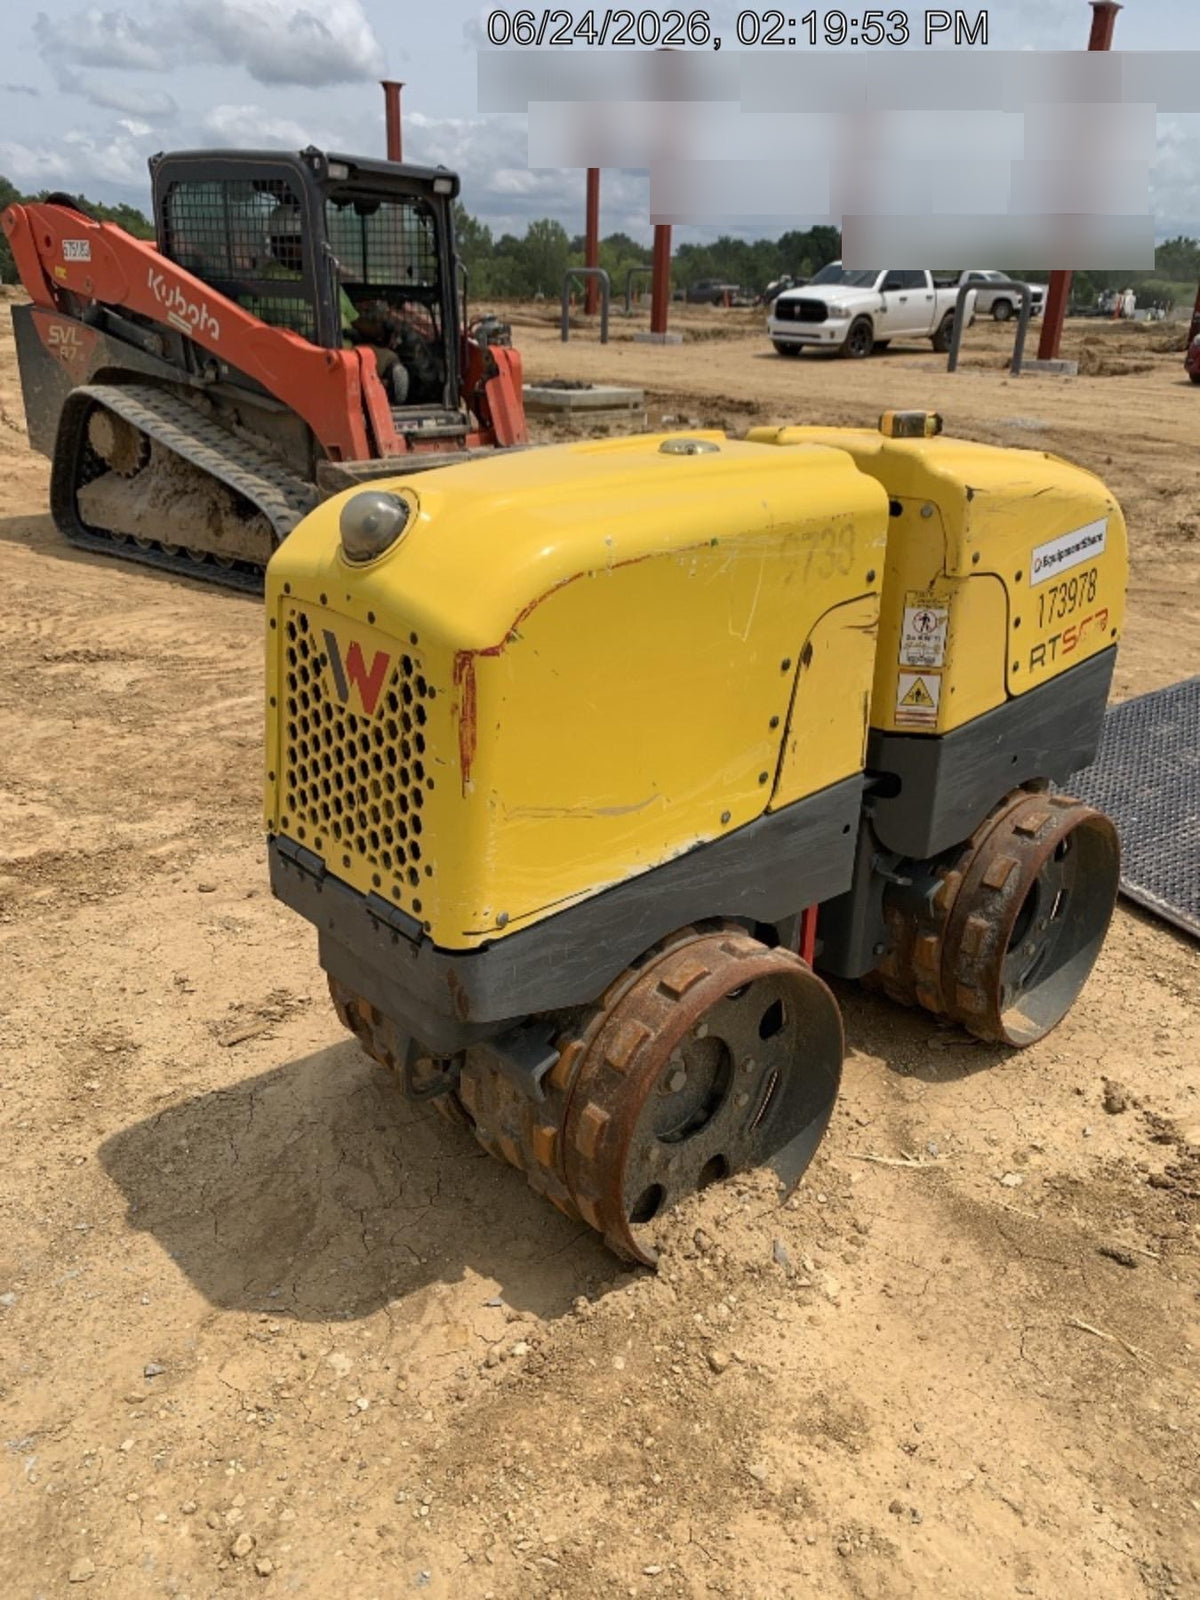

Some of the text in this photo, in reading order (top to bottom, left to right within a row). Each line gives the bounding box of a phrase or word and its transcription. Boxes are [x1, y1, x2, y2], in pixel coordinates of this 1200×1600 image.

[148, 267, 220, 340] Kubota
[48, 325, 83, 346] SVL
[1039, 567, 1098, 628] 173978
